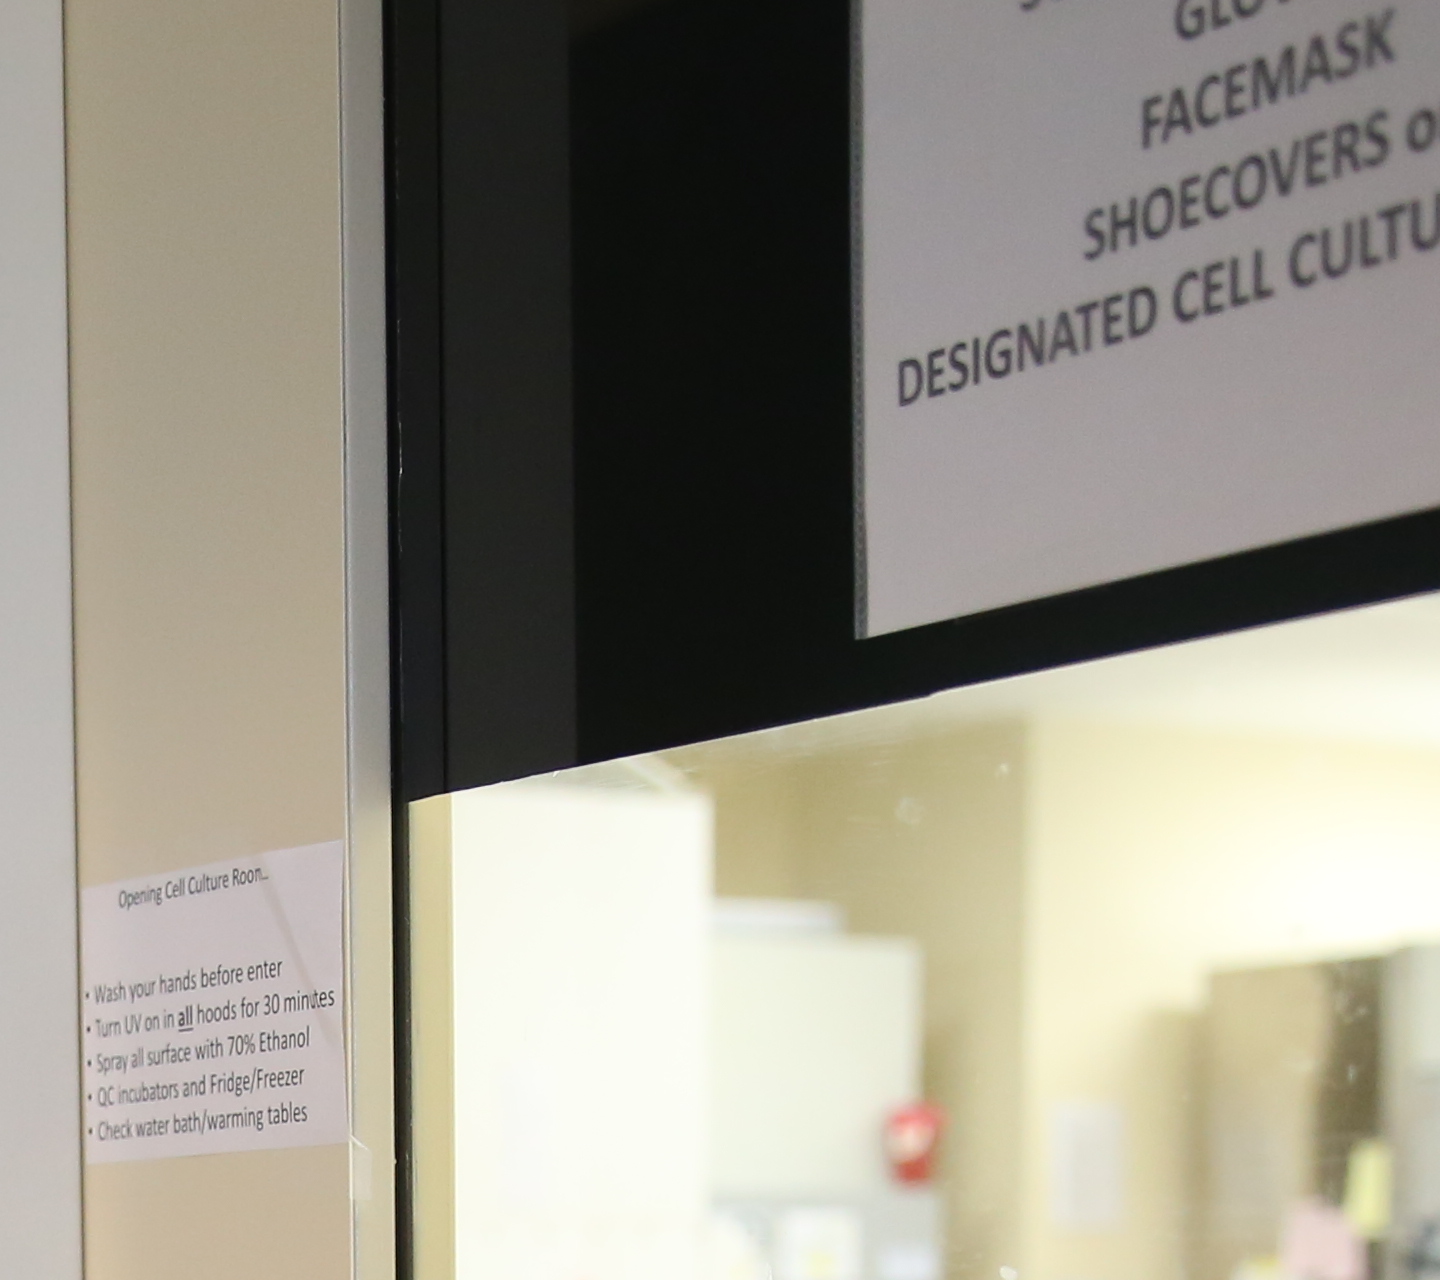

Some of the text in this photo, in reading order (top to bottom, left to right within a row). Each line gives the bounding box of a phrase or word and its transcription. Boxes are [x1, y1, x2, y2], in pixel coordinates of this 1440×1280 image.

[1140, 8, 1398, 149] FACEMASK
[1082, 107, 1390, 262] SHOECOVERS
[897, 285, 1158, 408] DESIGNATED
[1171, 248, 1275, 324] CELL
[118, 884, 163, 910] Opening
[165, 877, 186, 899] Cell
[187, 873, 229, 895] Culture
[95, 960, 283, 1004] Wash your hands before enter
[95, 989, 335, 1038] Turn UV on in all hoods for 30 minutes
[96, 1025, 310, 1076] Spray all surface with 70% Ethanol
[98, 1067, 305, 1108] QC incubators and Fridge/Freezer
[98, 1100, 308, 1141] Check water bath/warming tables
